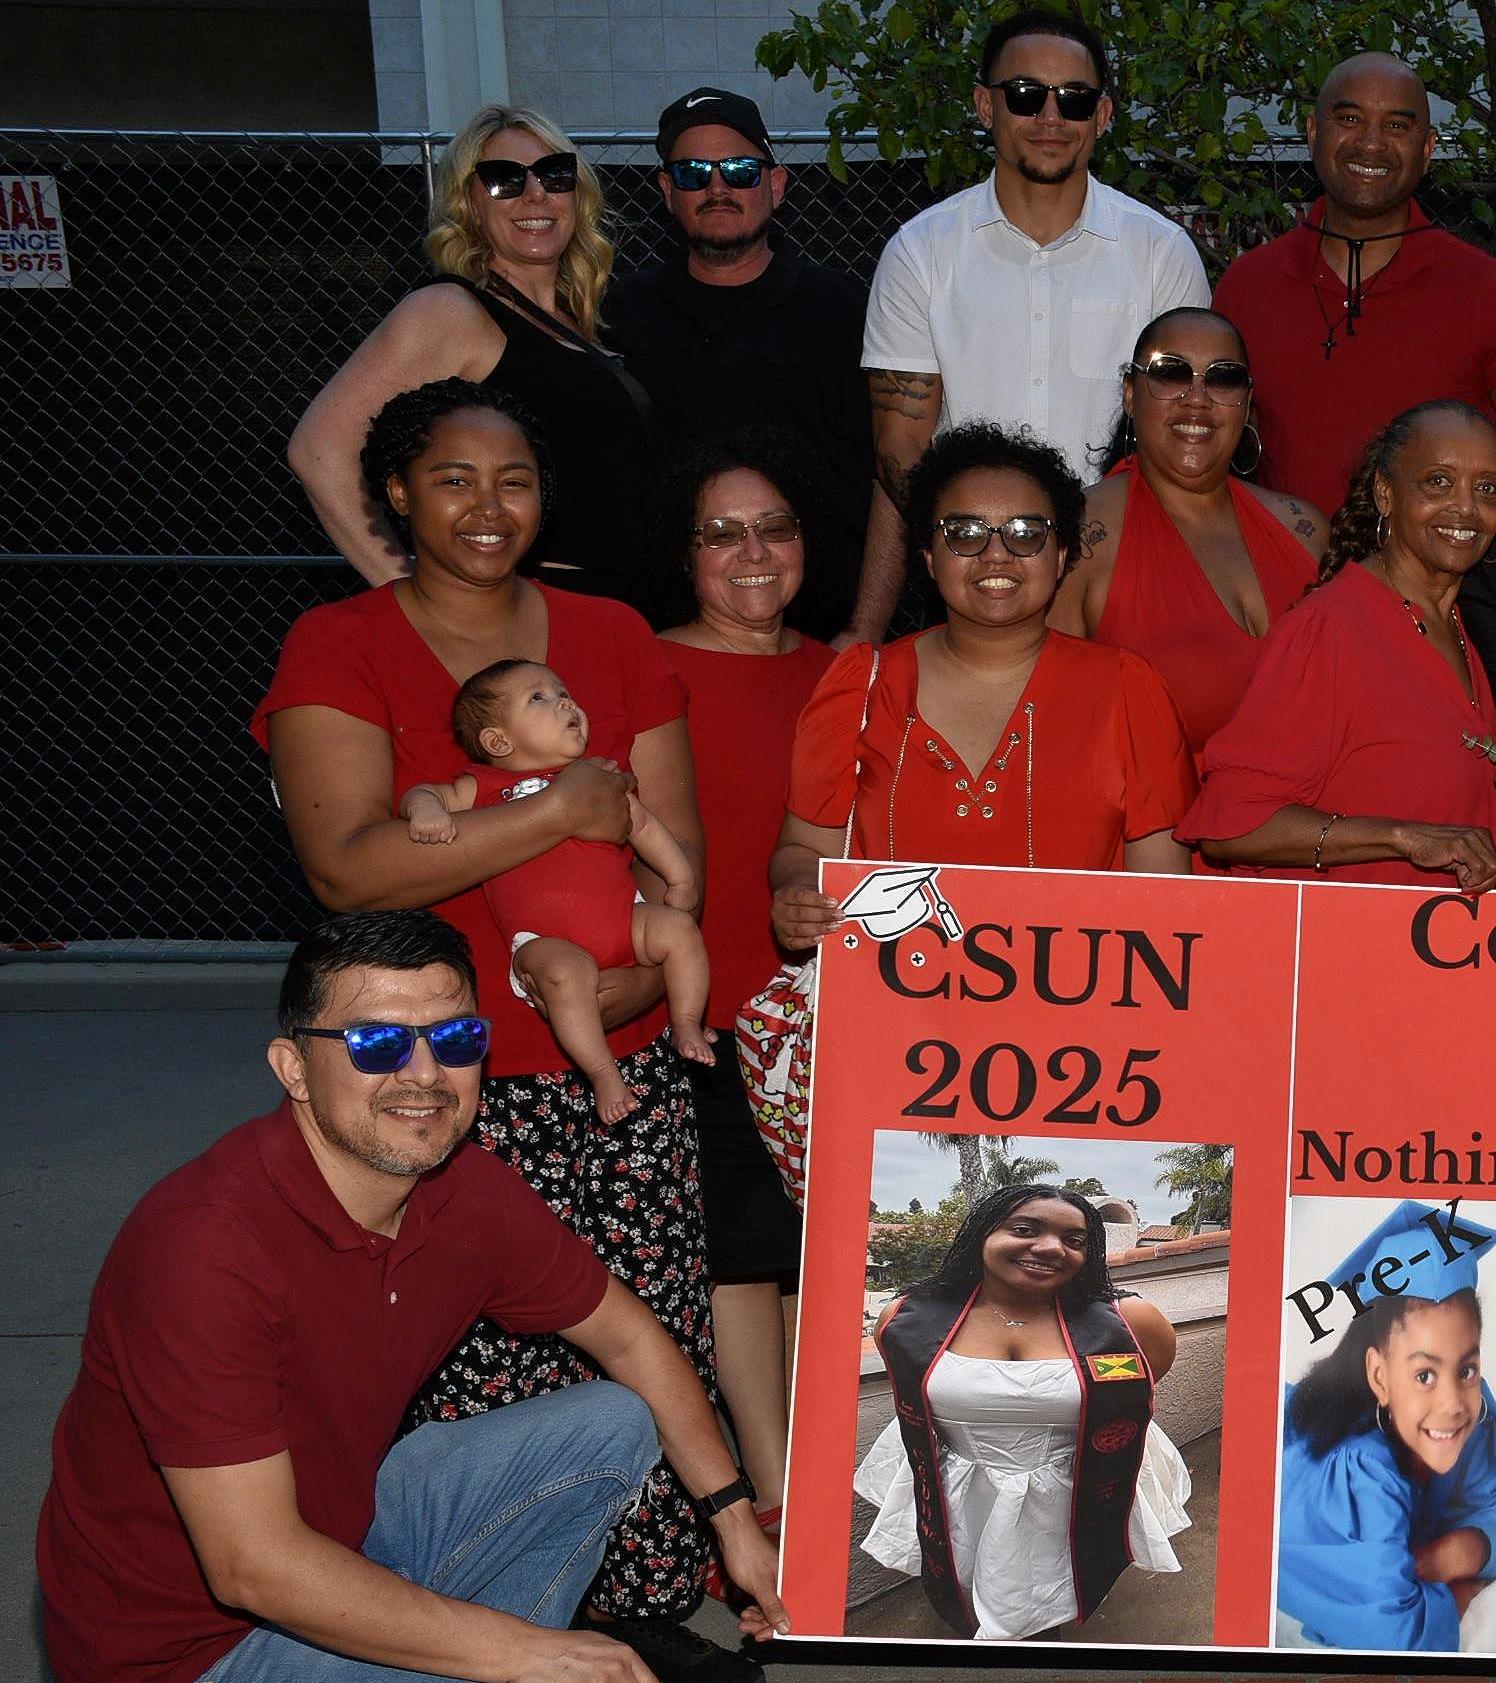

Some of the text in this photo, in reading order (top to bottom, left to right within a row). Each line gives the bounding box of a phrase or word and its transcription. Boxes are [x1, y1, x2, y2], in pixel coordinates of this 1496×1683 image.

[878, 921, 1204, 1011] CSUN
[901, 1039, 1162, 1127] 2025
[1286, 1195, 1492, 1344] Pre-K
